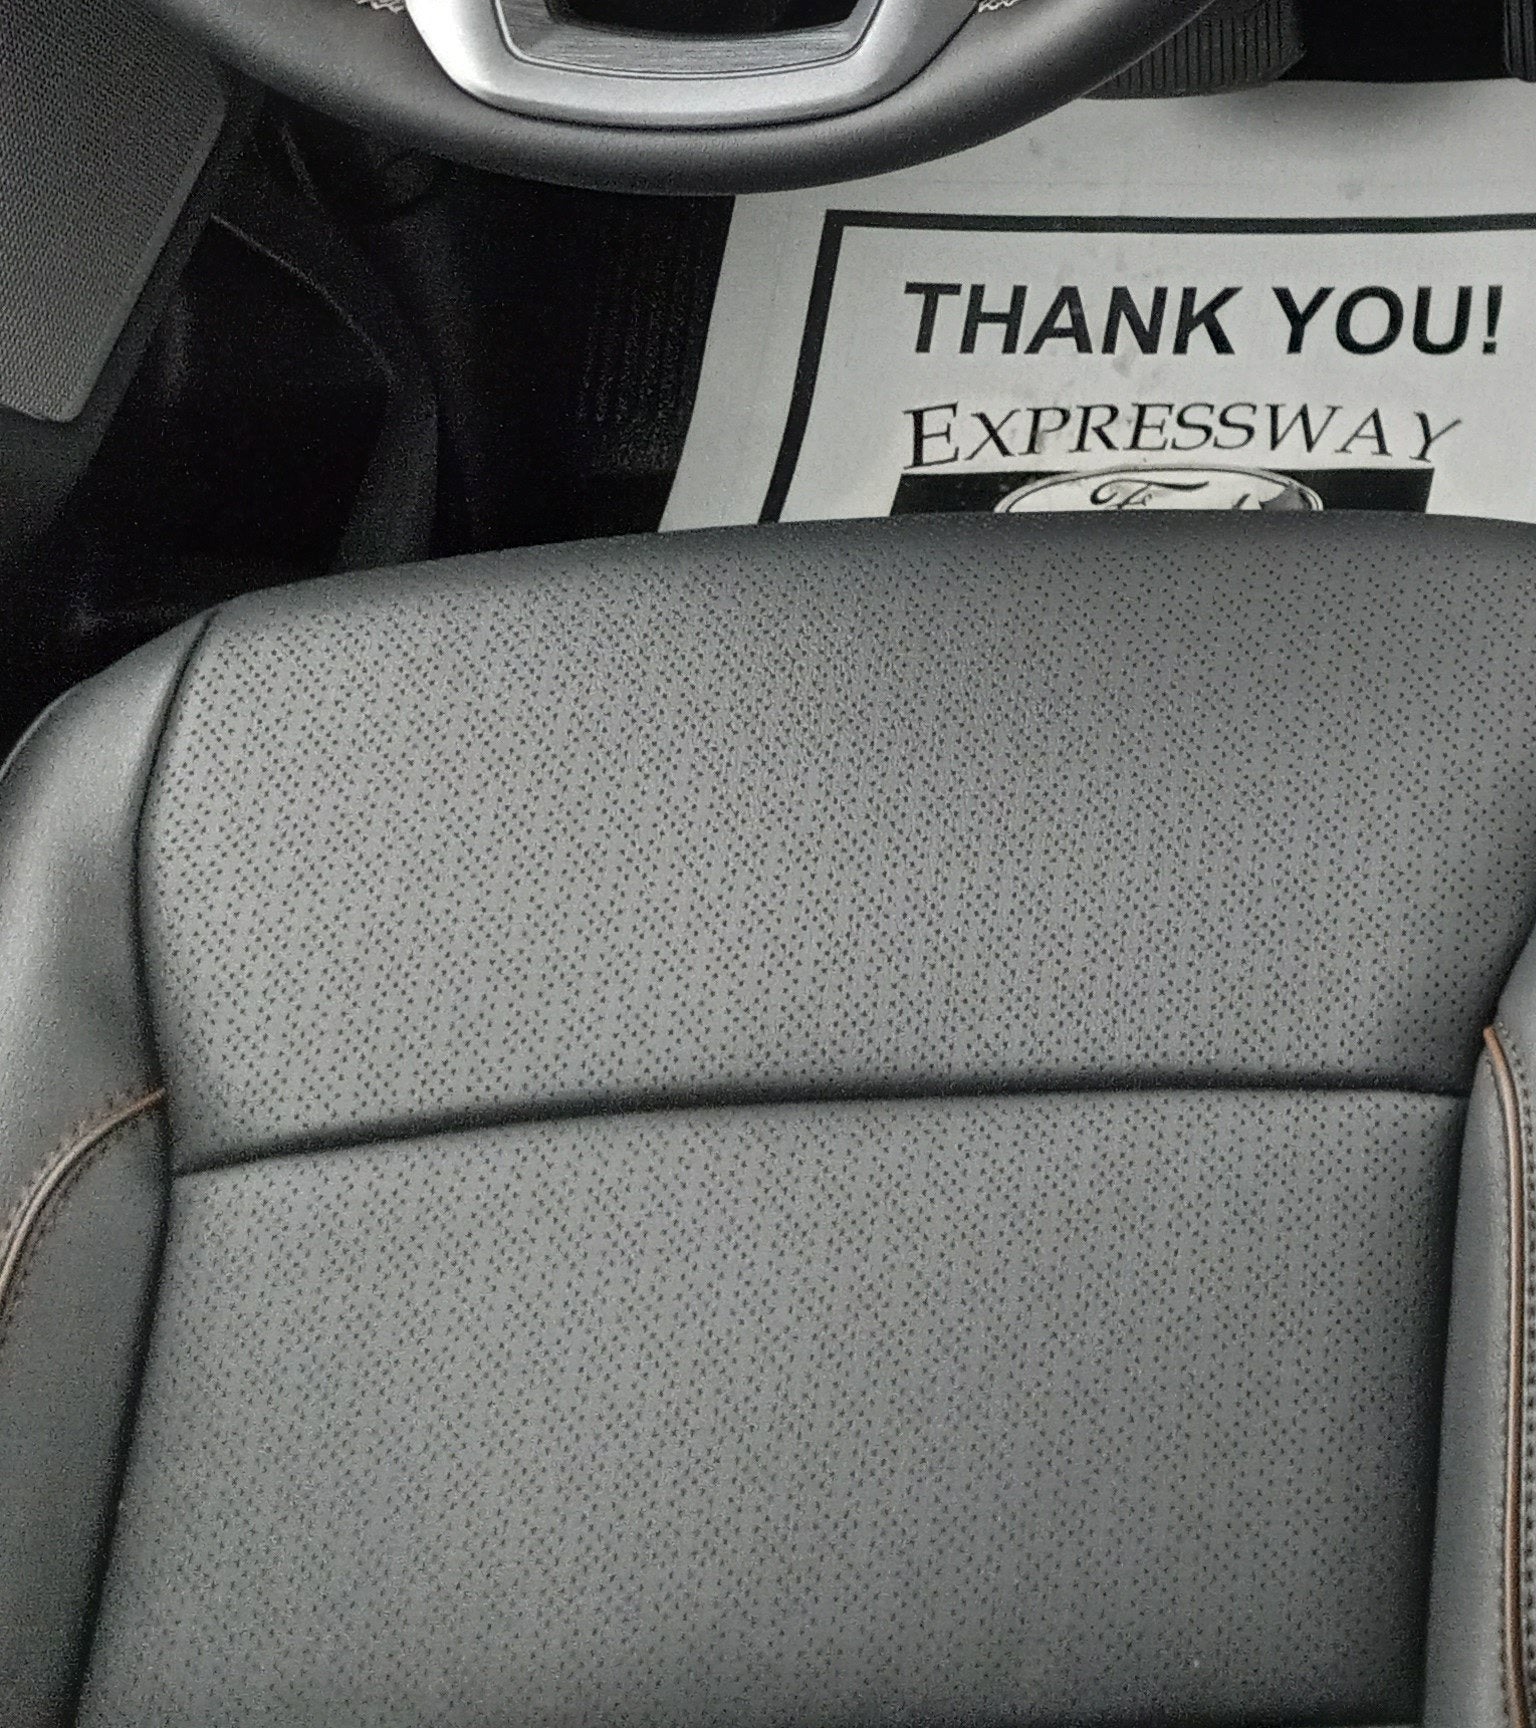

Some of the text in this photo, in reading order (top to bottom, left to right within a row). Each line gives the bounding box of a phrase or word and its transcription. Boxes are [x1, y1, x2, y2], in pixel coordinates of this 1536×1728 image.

[903, 280, 1503, 357] THANK YOU!
[902, 401, 1462, 471] EXPRESSWAY
